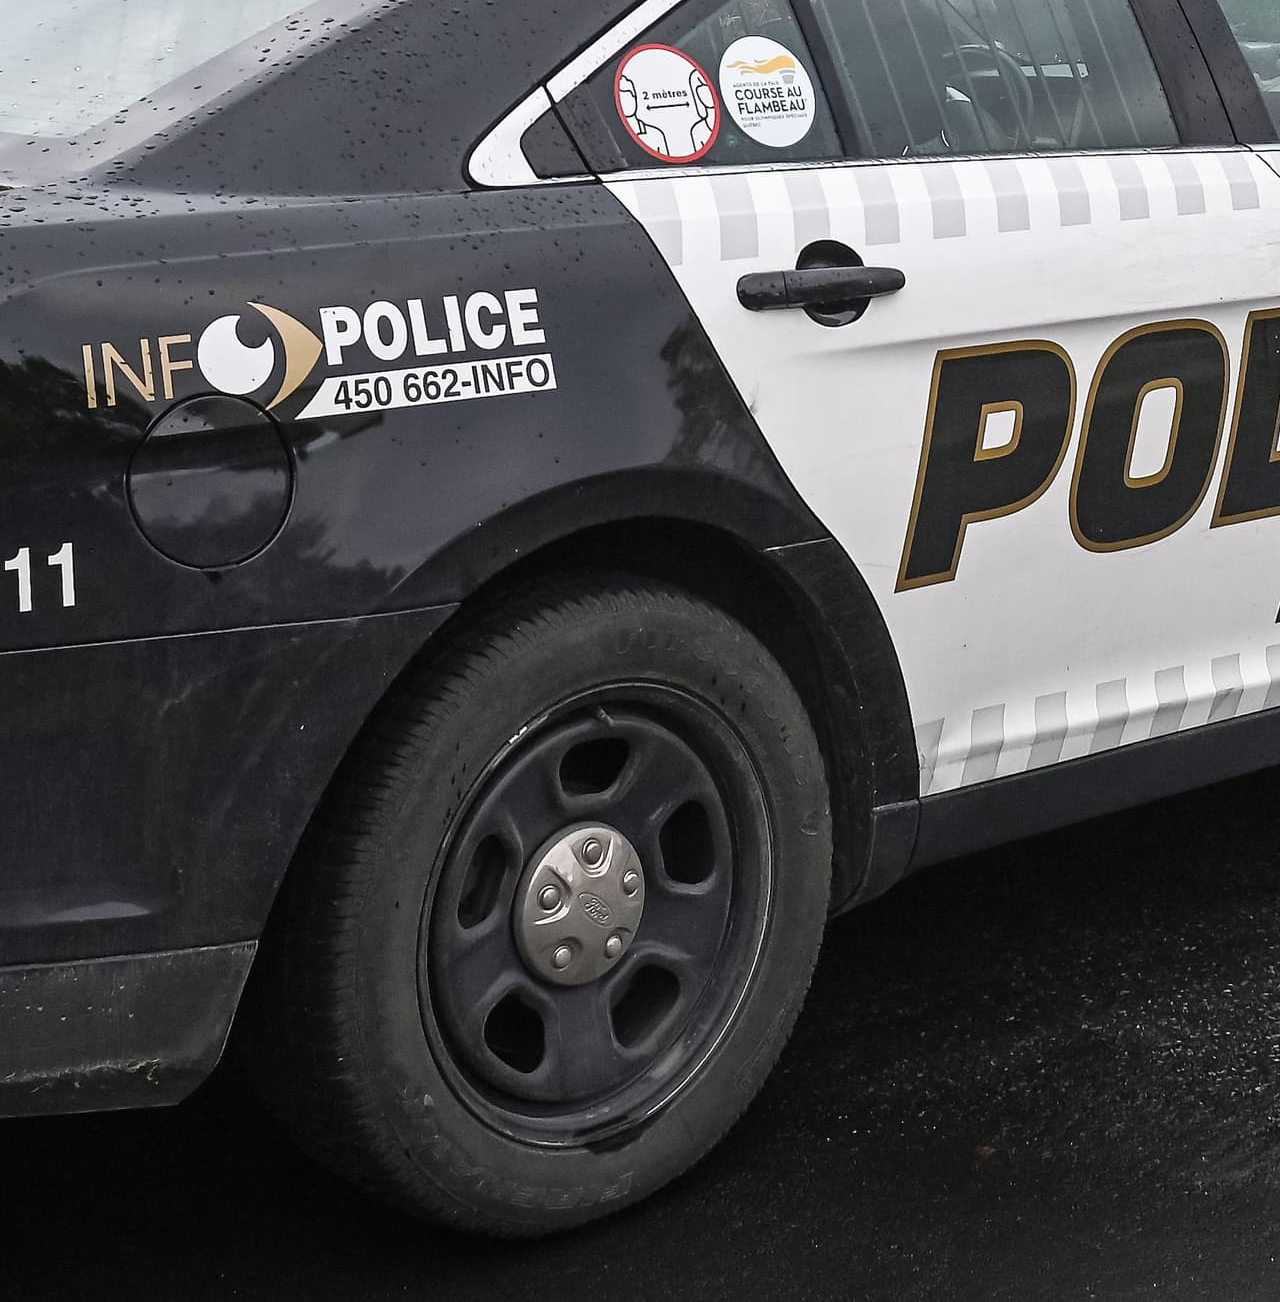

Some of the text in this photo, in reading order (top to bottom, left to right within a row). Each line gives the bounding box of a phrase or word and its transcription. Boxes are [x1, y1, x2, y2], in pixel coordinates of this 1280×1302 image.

[642, 89, 688, 100] 2 mètres
[735, 85, 802, 101] COURSE AU
[738, 98, 805, 114] FLAMBEAU
[319, 288, 547, 366] POLICE
[334, 359, 551, 410] 450 662-INFO
